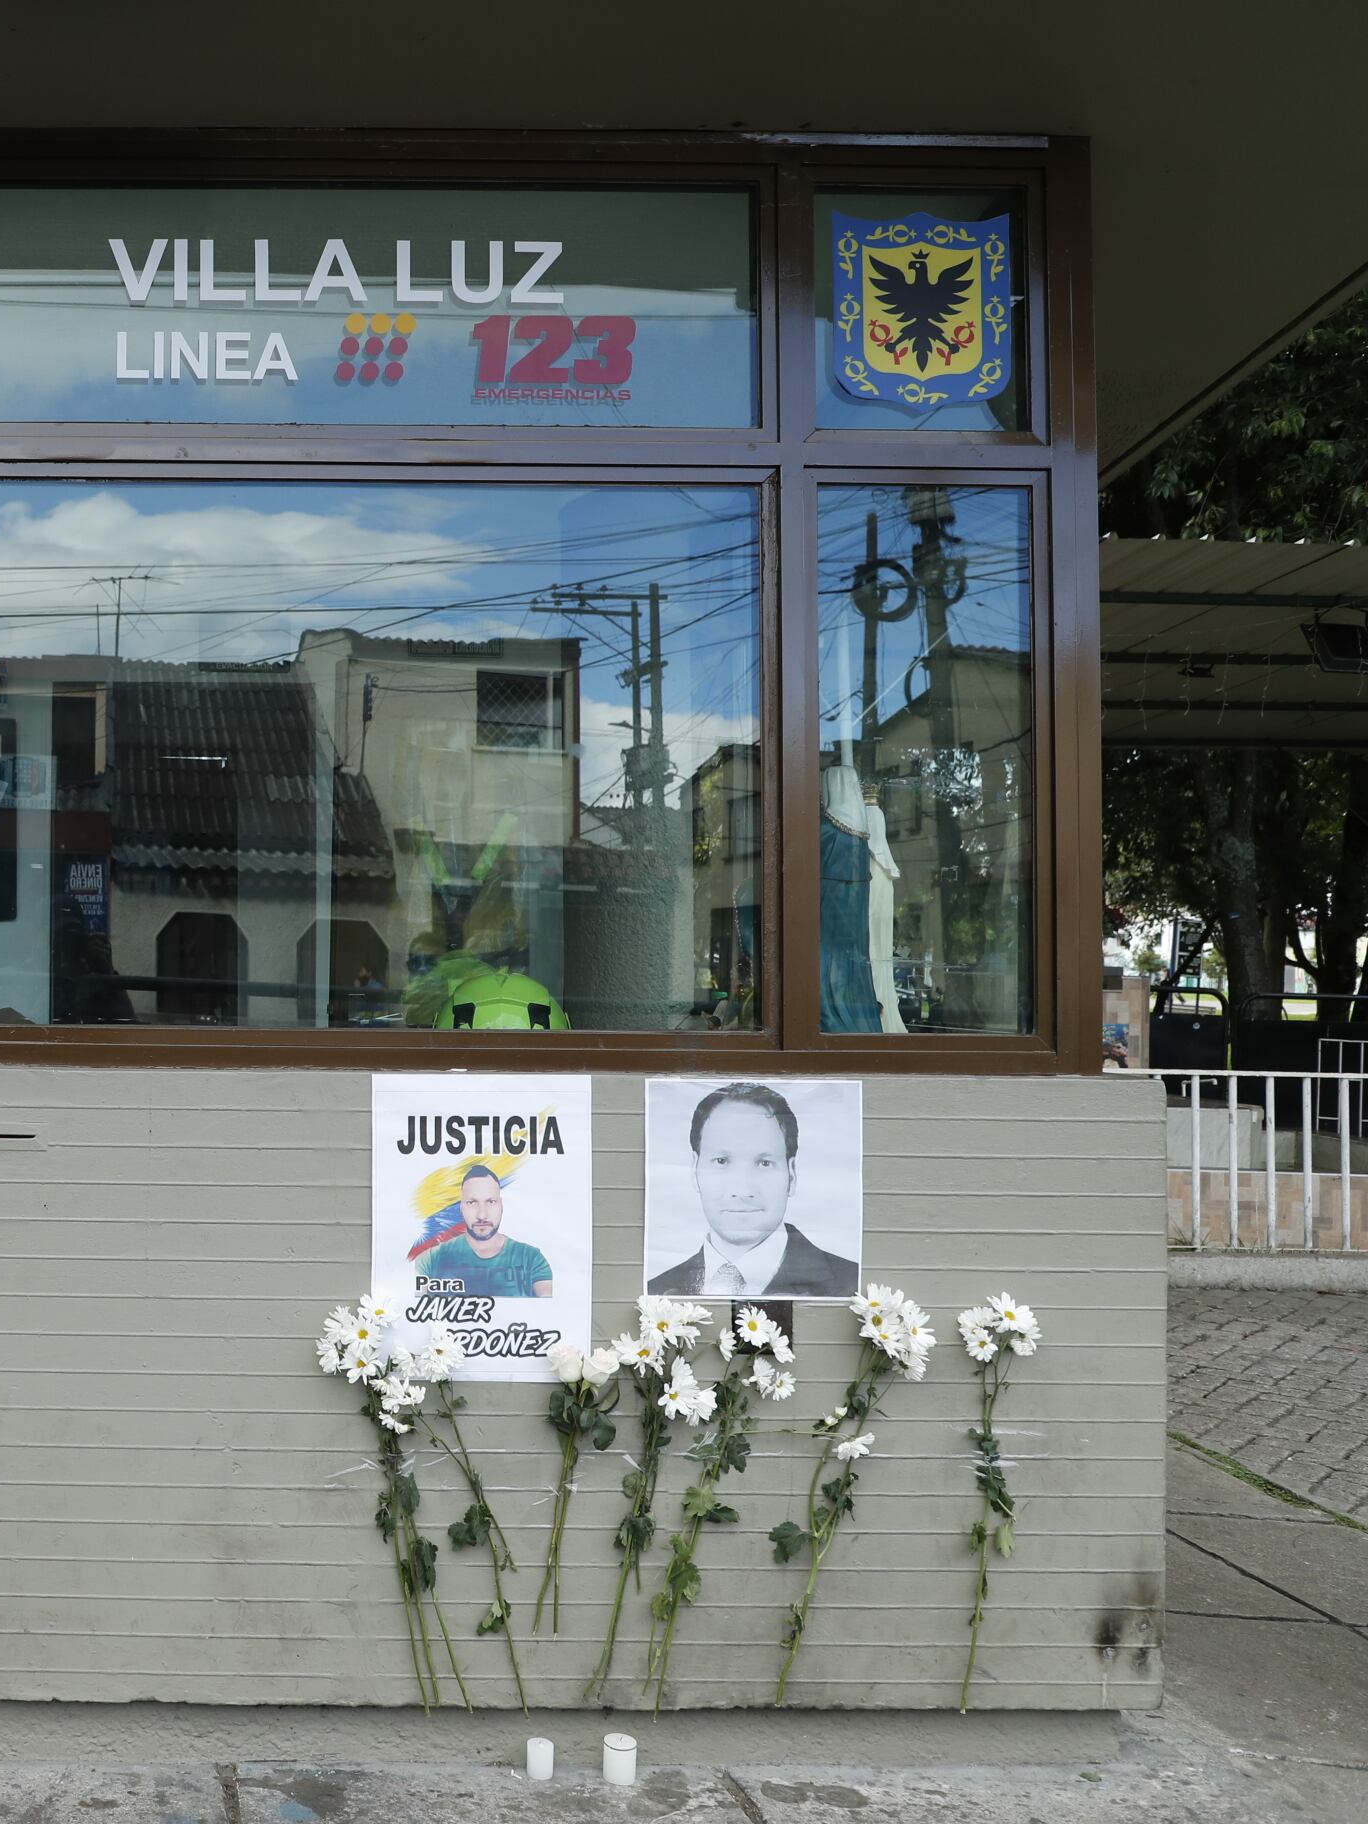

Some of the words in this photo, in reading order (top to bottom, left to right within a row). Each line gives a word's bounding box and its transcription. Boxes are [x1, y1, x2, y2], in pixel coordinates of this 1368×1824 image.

[108, 238, 368, 302] VILLA
[396, 239, 564, 304] LUZ
[116, 331, 299, 381] LINEA
[472, 314, 637, 385] 123
[473, 387, 632, 401] EMERGENCIAS
[396, 1115, 565, 1156] JUSTICIA
[415, 1275, 464, 1292] Para
[405, 1295, 496, 1323] JAVIER
[446, 1322, 562, 1358] RDOÑEZ
